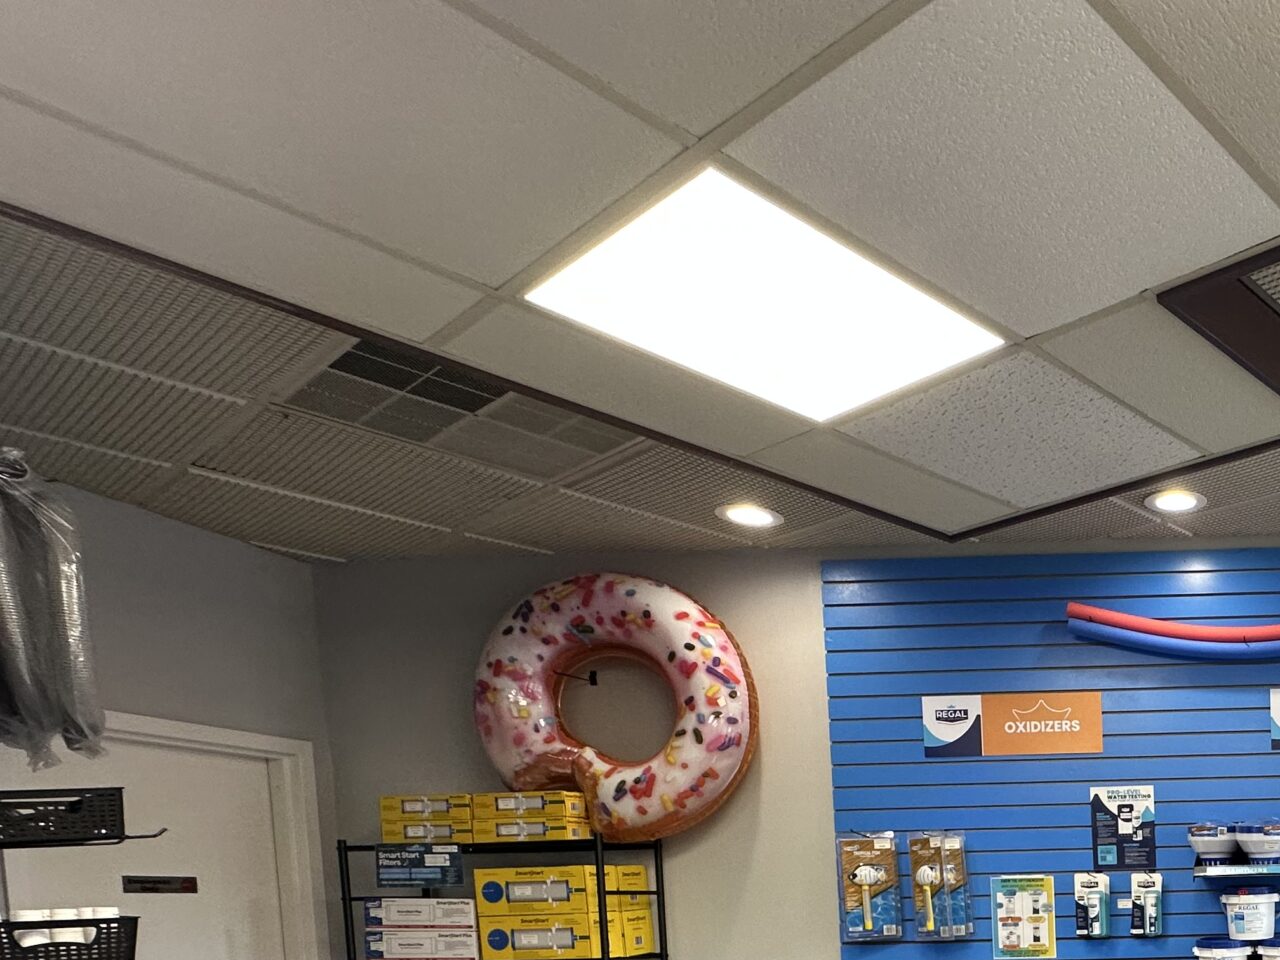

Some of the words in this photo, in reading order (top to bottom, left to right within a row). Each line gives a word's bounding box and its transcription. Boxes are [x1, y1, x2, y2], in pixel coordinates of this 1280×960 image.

[936, 710, 967, 718] REGAL
[1004, 720, 1080, 734] OXIDIZERS
[378, 852, 400, 860] Smart
[379, 859, 402, 867] Filters
